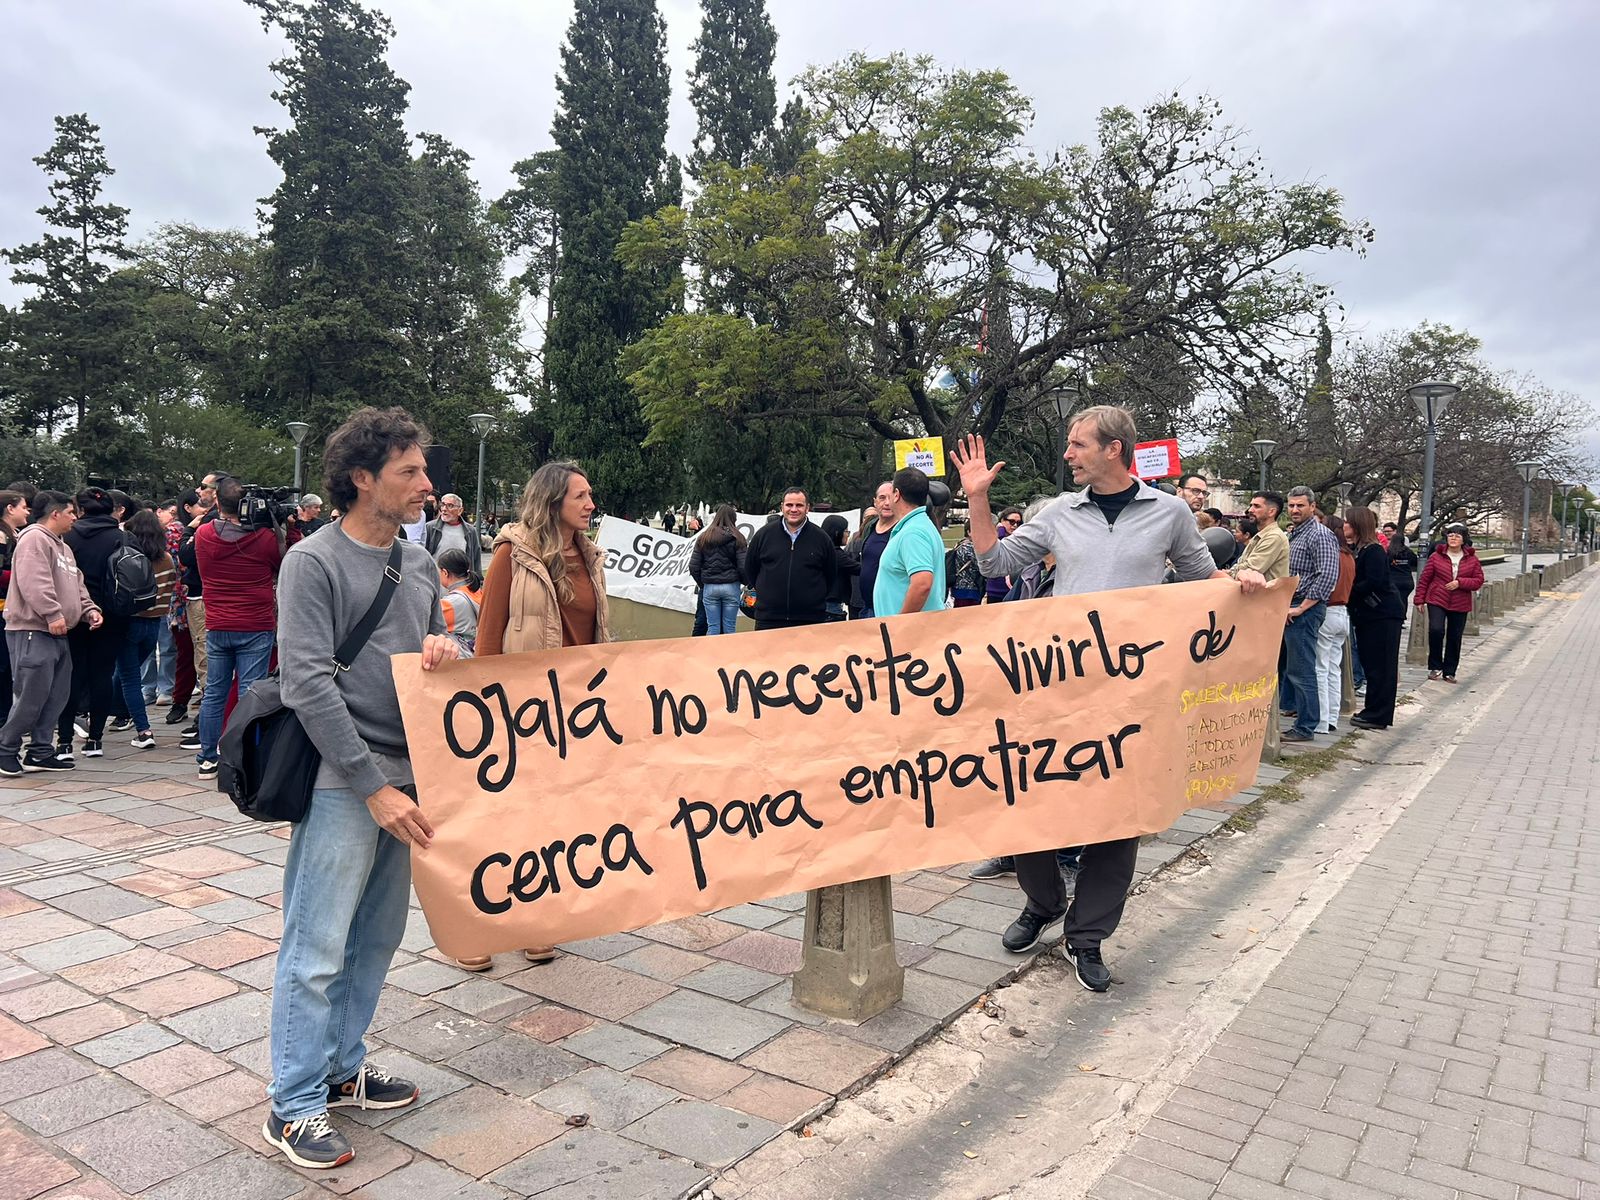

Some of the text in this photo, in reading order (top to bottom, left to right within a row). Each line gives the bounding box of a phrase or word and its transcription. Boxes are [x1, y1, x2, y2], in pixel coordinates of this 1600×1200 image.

[443, 668, 624, 793] Ojalá
[646, 684, 708, 737] no
[717, 622, 965, 718] necesites
[1189, 610, 1236, 664] de
[1199, 712, 1245, 735] ADULTOS
[470, 717, 1142, 915] cerca para empatizar
